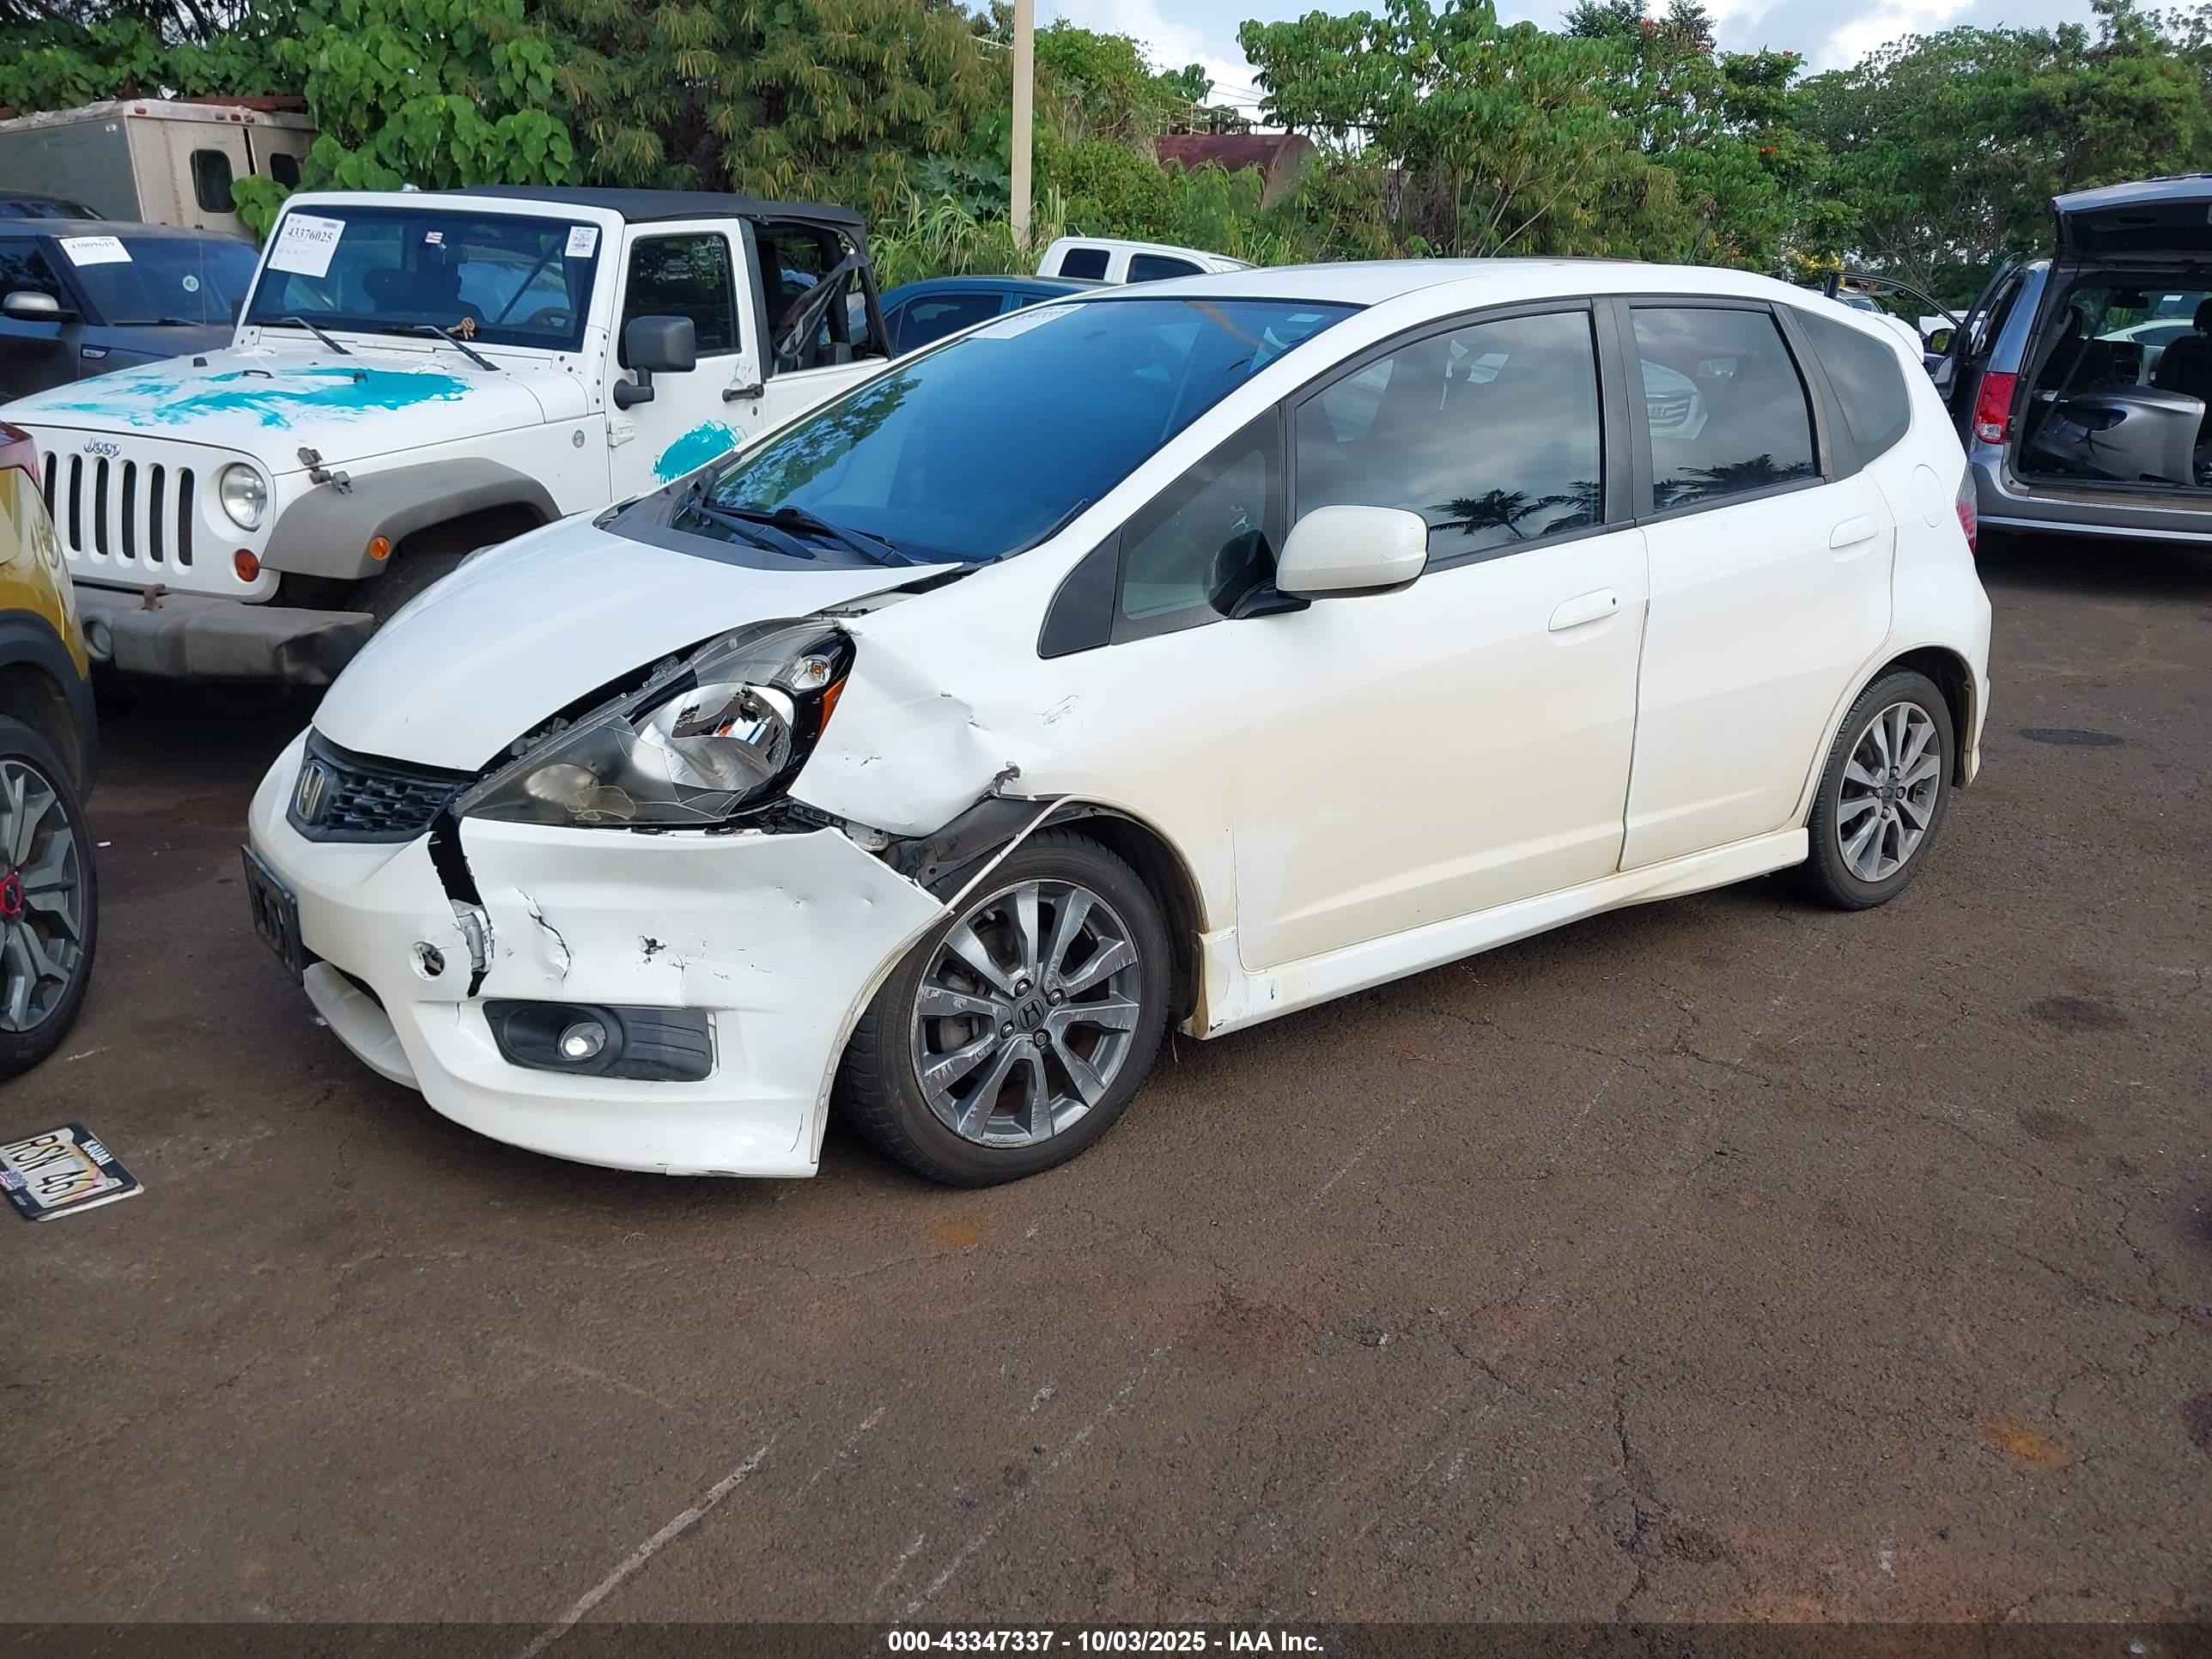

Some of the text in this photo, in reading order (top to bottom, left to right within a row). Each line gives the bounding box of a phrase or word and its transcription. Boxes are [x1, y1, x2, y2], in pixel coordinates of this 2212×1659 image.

[288, 227, 333, 243] 43376025
[83, 437, 122, 459] Jeep
[80, 1139, 115, 1167] KAUAI
[3, 1134, 103, 1203] RSN 461
